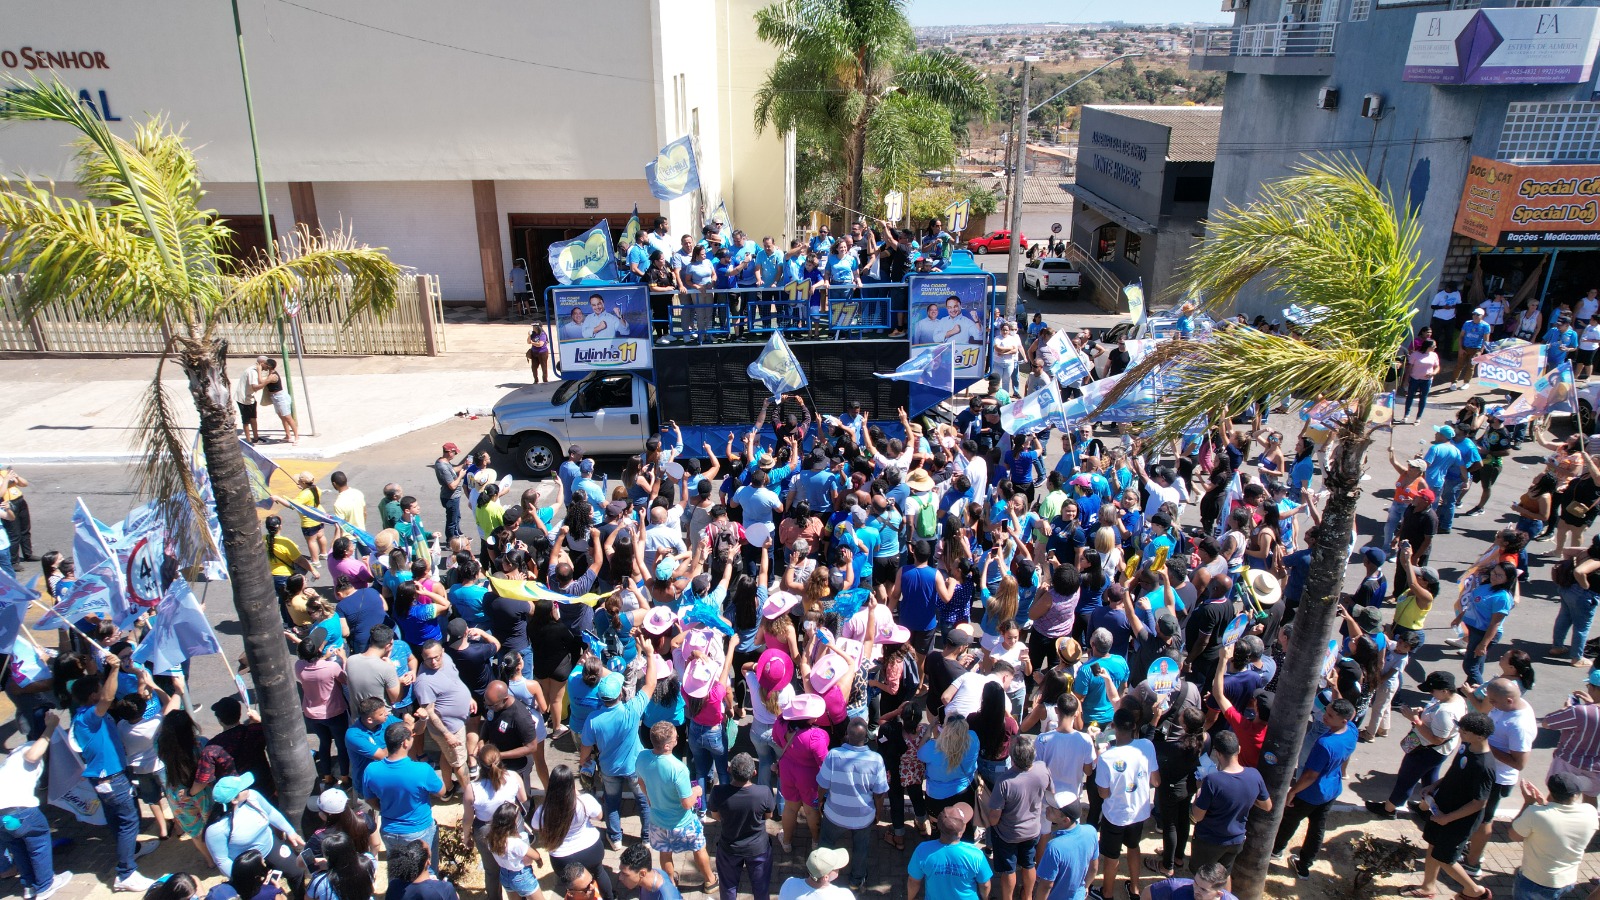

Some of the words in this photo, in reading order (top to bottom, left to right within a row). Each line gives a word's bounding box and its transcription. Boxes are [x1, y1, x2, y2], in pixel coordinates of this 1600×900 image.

[1507, 43, 1536, 51] ESTEVES
[1548, 42, 1578, 50] ALMEIDA
[1470, 165, 1487, 177] DOG
[1497, 171, 1513, 185] CAT
[1519, 179, 1577, 198] Special
[884, 192, 903, 221] 11
[944, 199, 970, 233] 11
[1513, 205, 1569, 223] Special
[1568, 201, 1597, 223] Dog
[1507, 233, 1538, 242] Rações
[784, 279, 811, 302] 11
[574, 346, 620, 364] Lulinha
[618, 341, 638, 361] 11
[962, 347, 979, 367] 11
